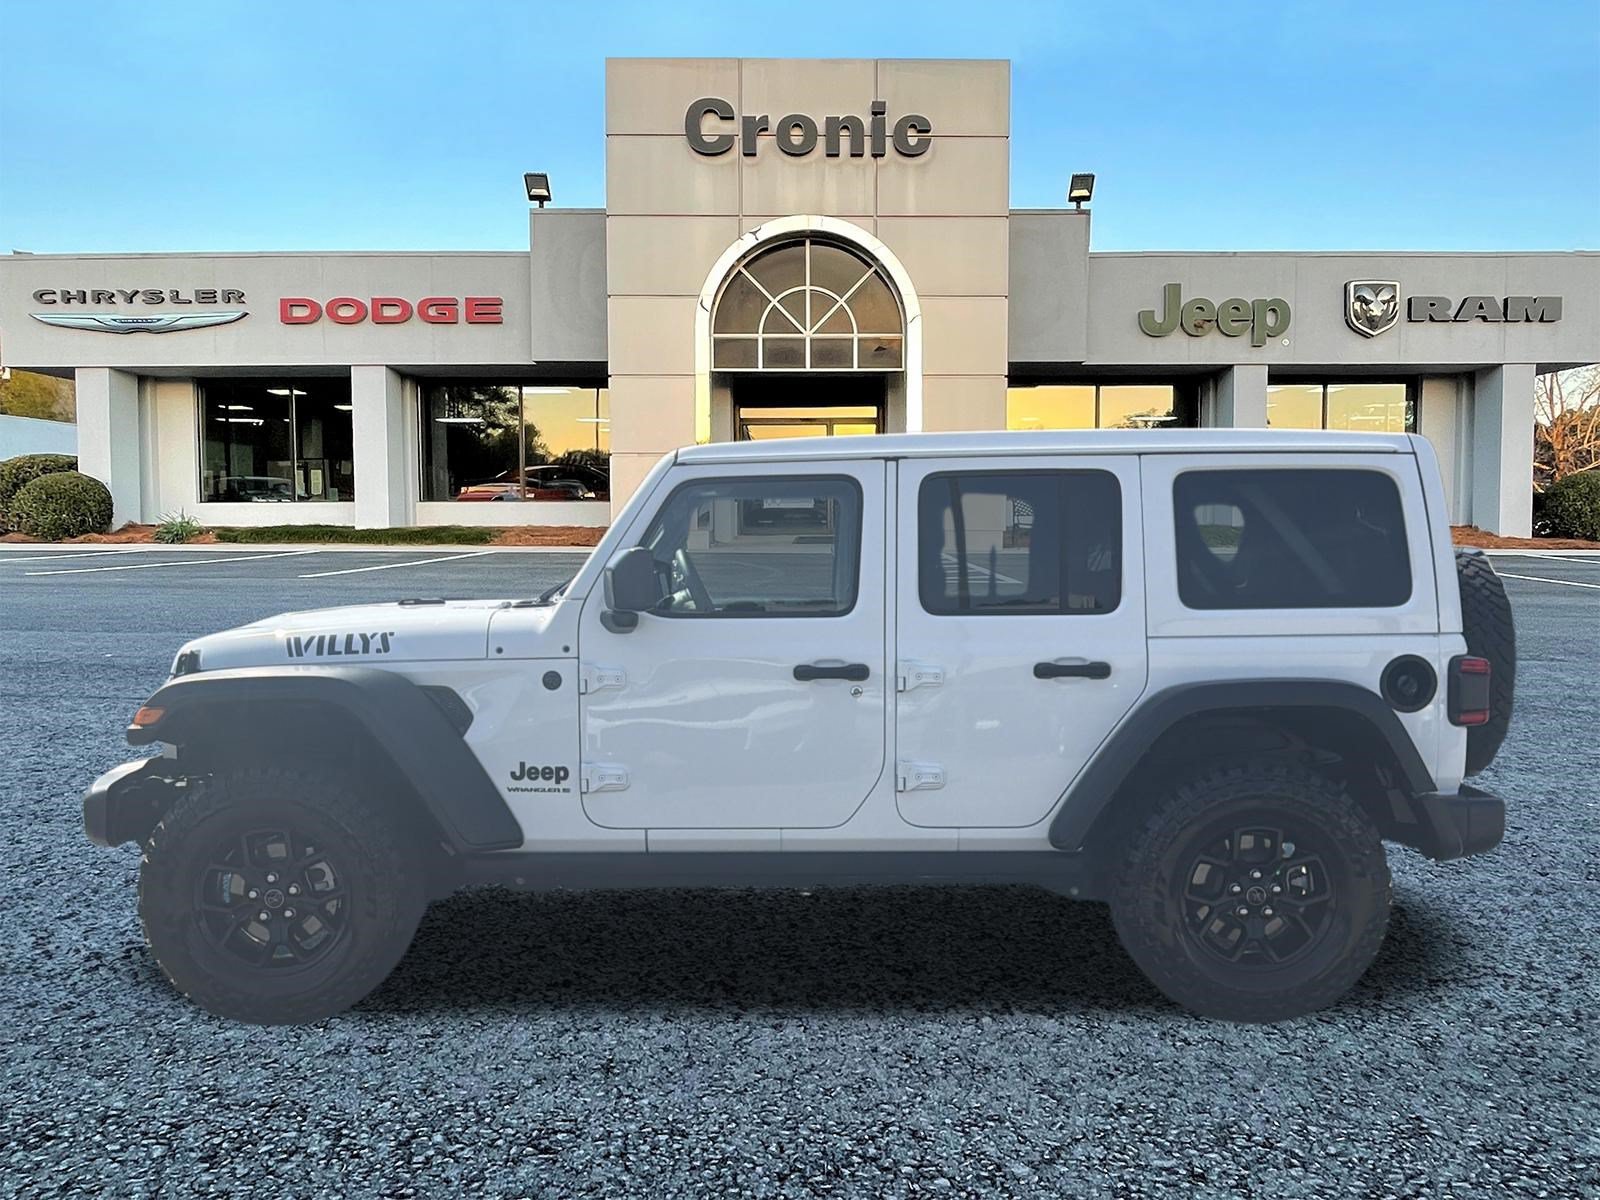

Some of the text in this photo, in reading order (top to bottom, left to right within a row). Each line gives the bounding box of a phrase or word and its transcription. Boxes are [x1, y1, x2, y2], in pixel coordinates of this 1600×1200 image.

[685, 97, 932, 158] Cronic
[32, 289, 246, 305] CHRYSLER
[1407, 296, 1563, 322] RAM
[280, 297, 503, 325] DODGE
[1138, 283, 1291, 347] Jeep
[286, 632, 395, 658] WILLYS
[510, 761, 569, 785] Jeep
[506, 786, 561, 794] WRANGLER
